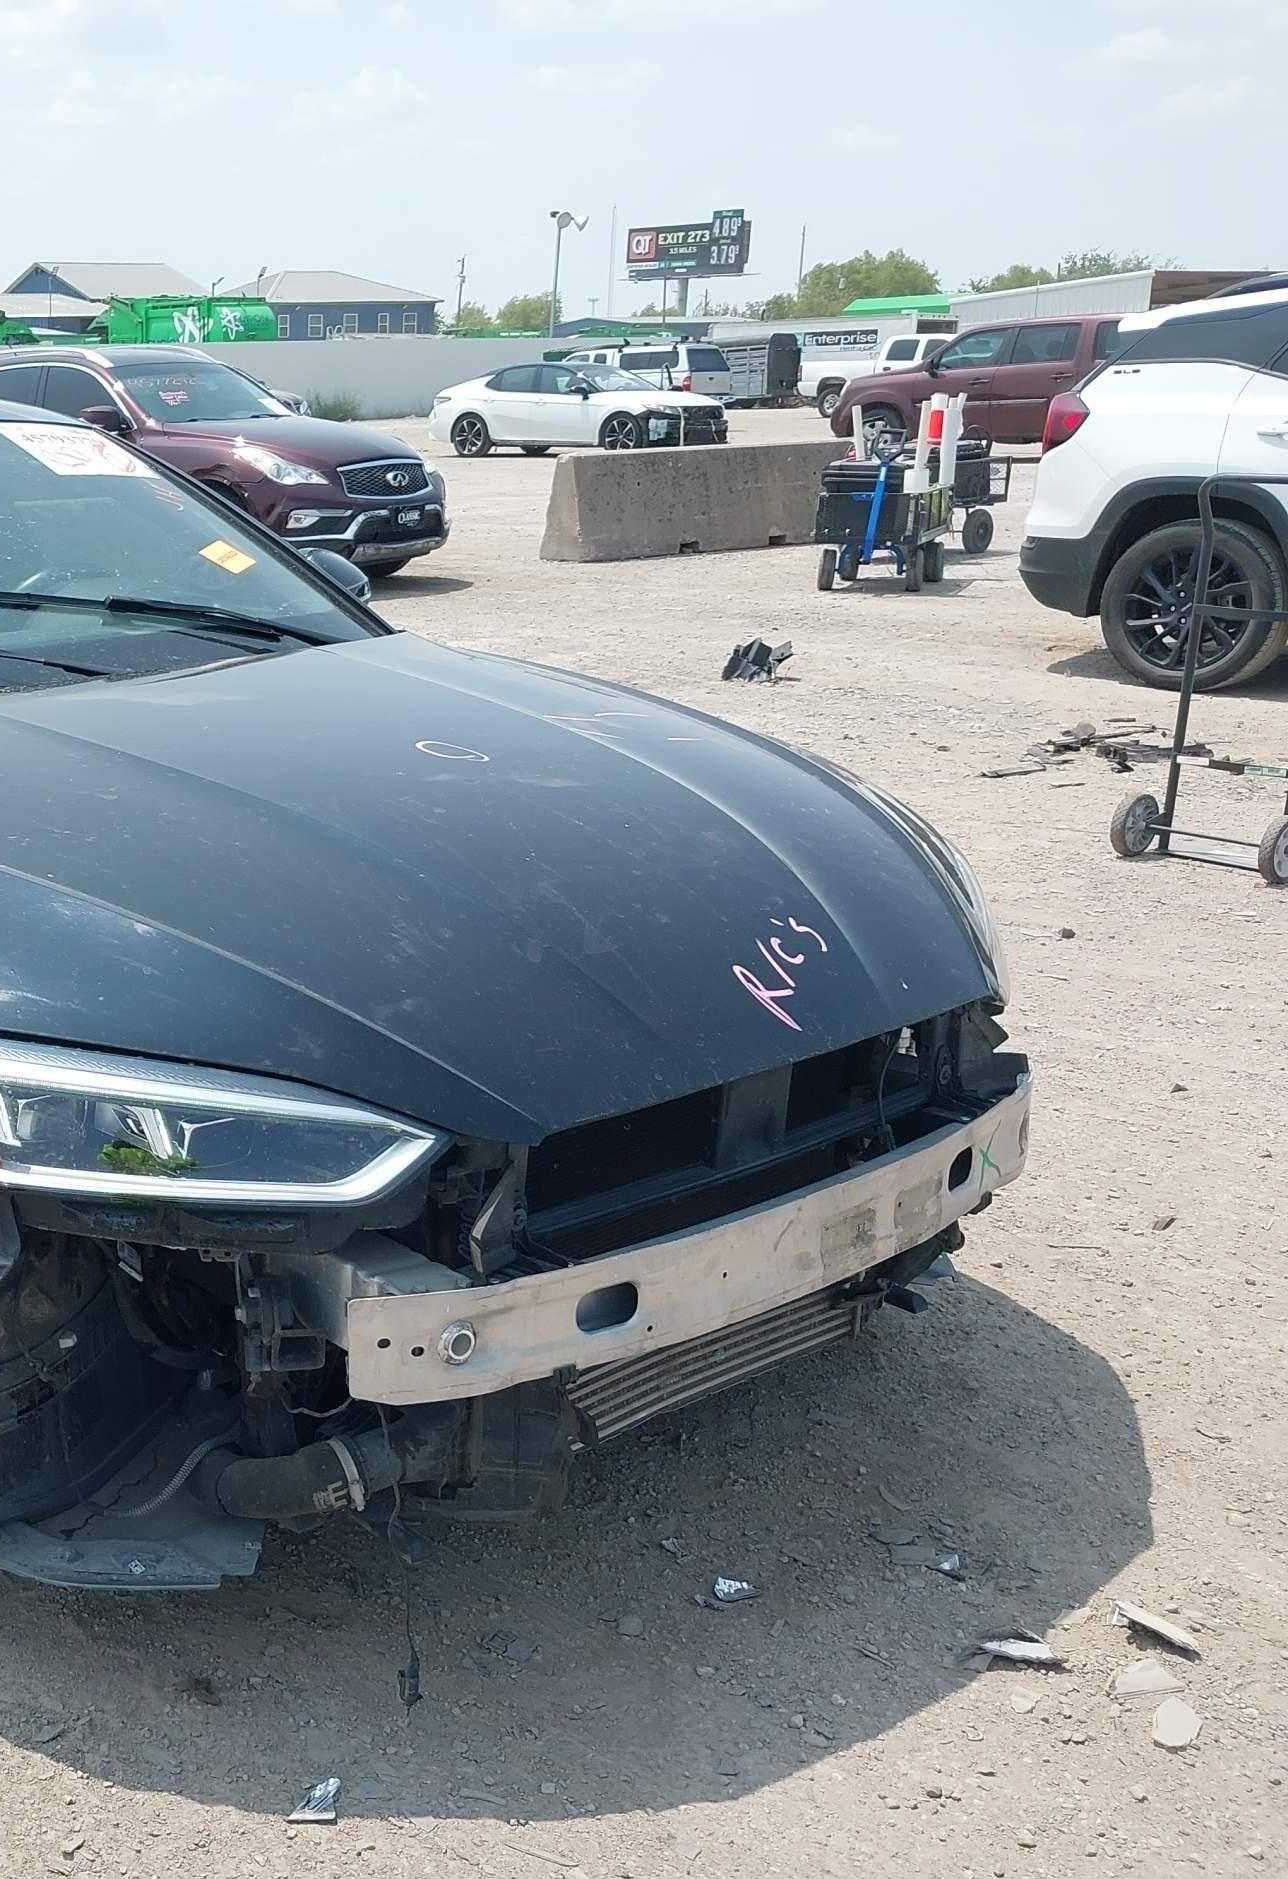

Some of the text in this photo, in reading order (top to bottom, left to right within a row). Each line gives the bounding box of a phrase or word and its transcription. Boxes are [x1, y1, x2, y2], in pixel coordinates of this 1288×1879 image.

[657, 229, 710, 245] EXIT 273
[805, 331, 877, 346] Enterprise
